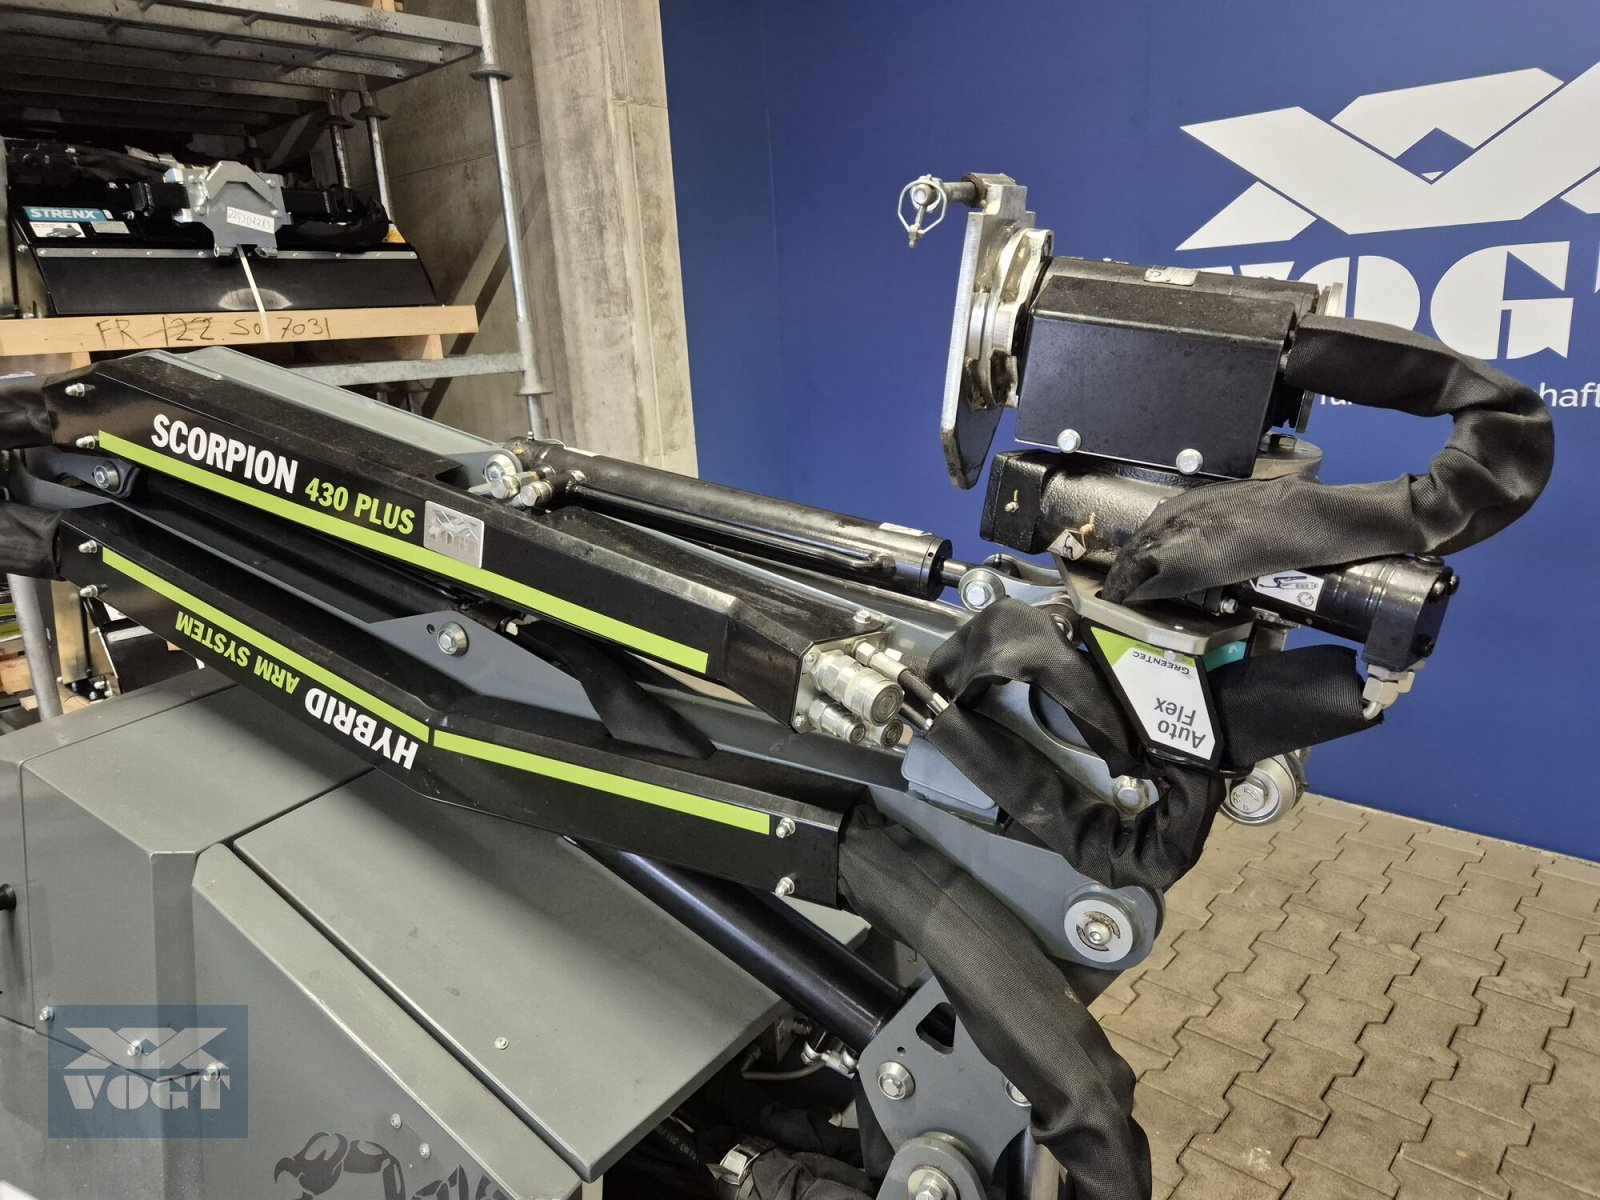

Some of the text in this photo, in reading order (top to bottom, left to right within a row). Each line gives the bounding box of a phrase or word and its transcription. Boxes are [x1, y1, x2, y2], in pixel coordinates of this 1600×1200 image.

[30, 208, 96, 219] STRENX
[150, 413, 415, 535] SCORPION 430 PLUS
[1132, 651, 1190, 675] GREENTEC
[175, 611, 419, 770] HYBRID ARM SYSTEM
[1154, 697, 1196, 727] Flex
[1157, 720, 1206, 749] Auto
